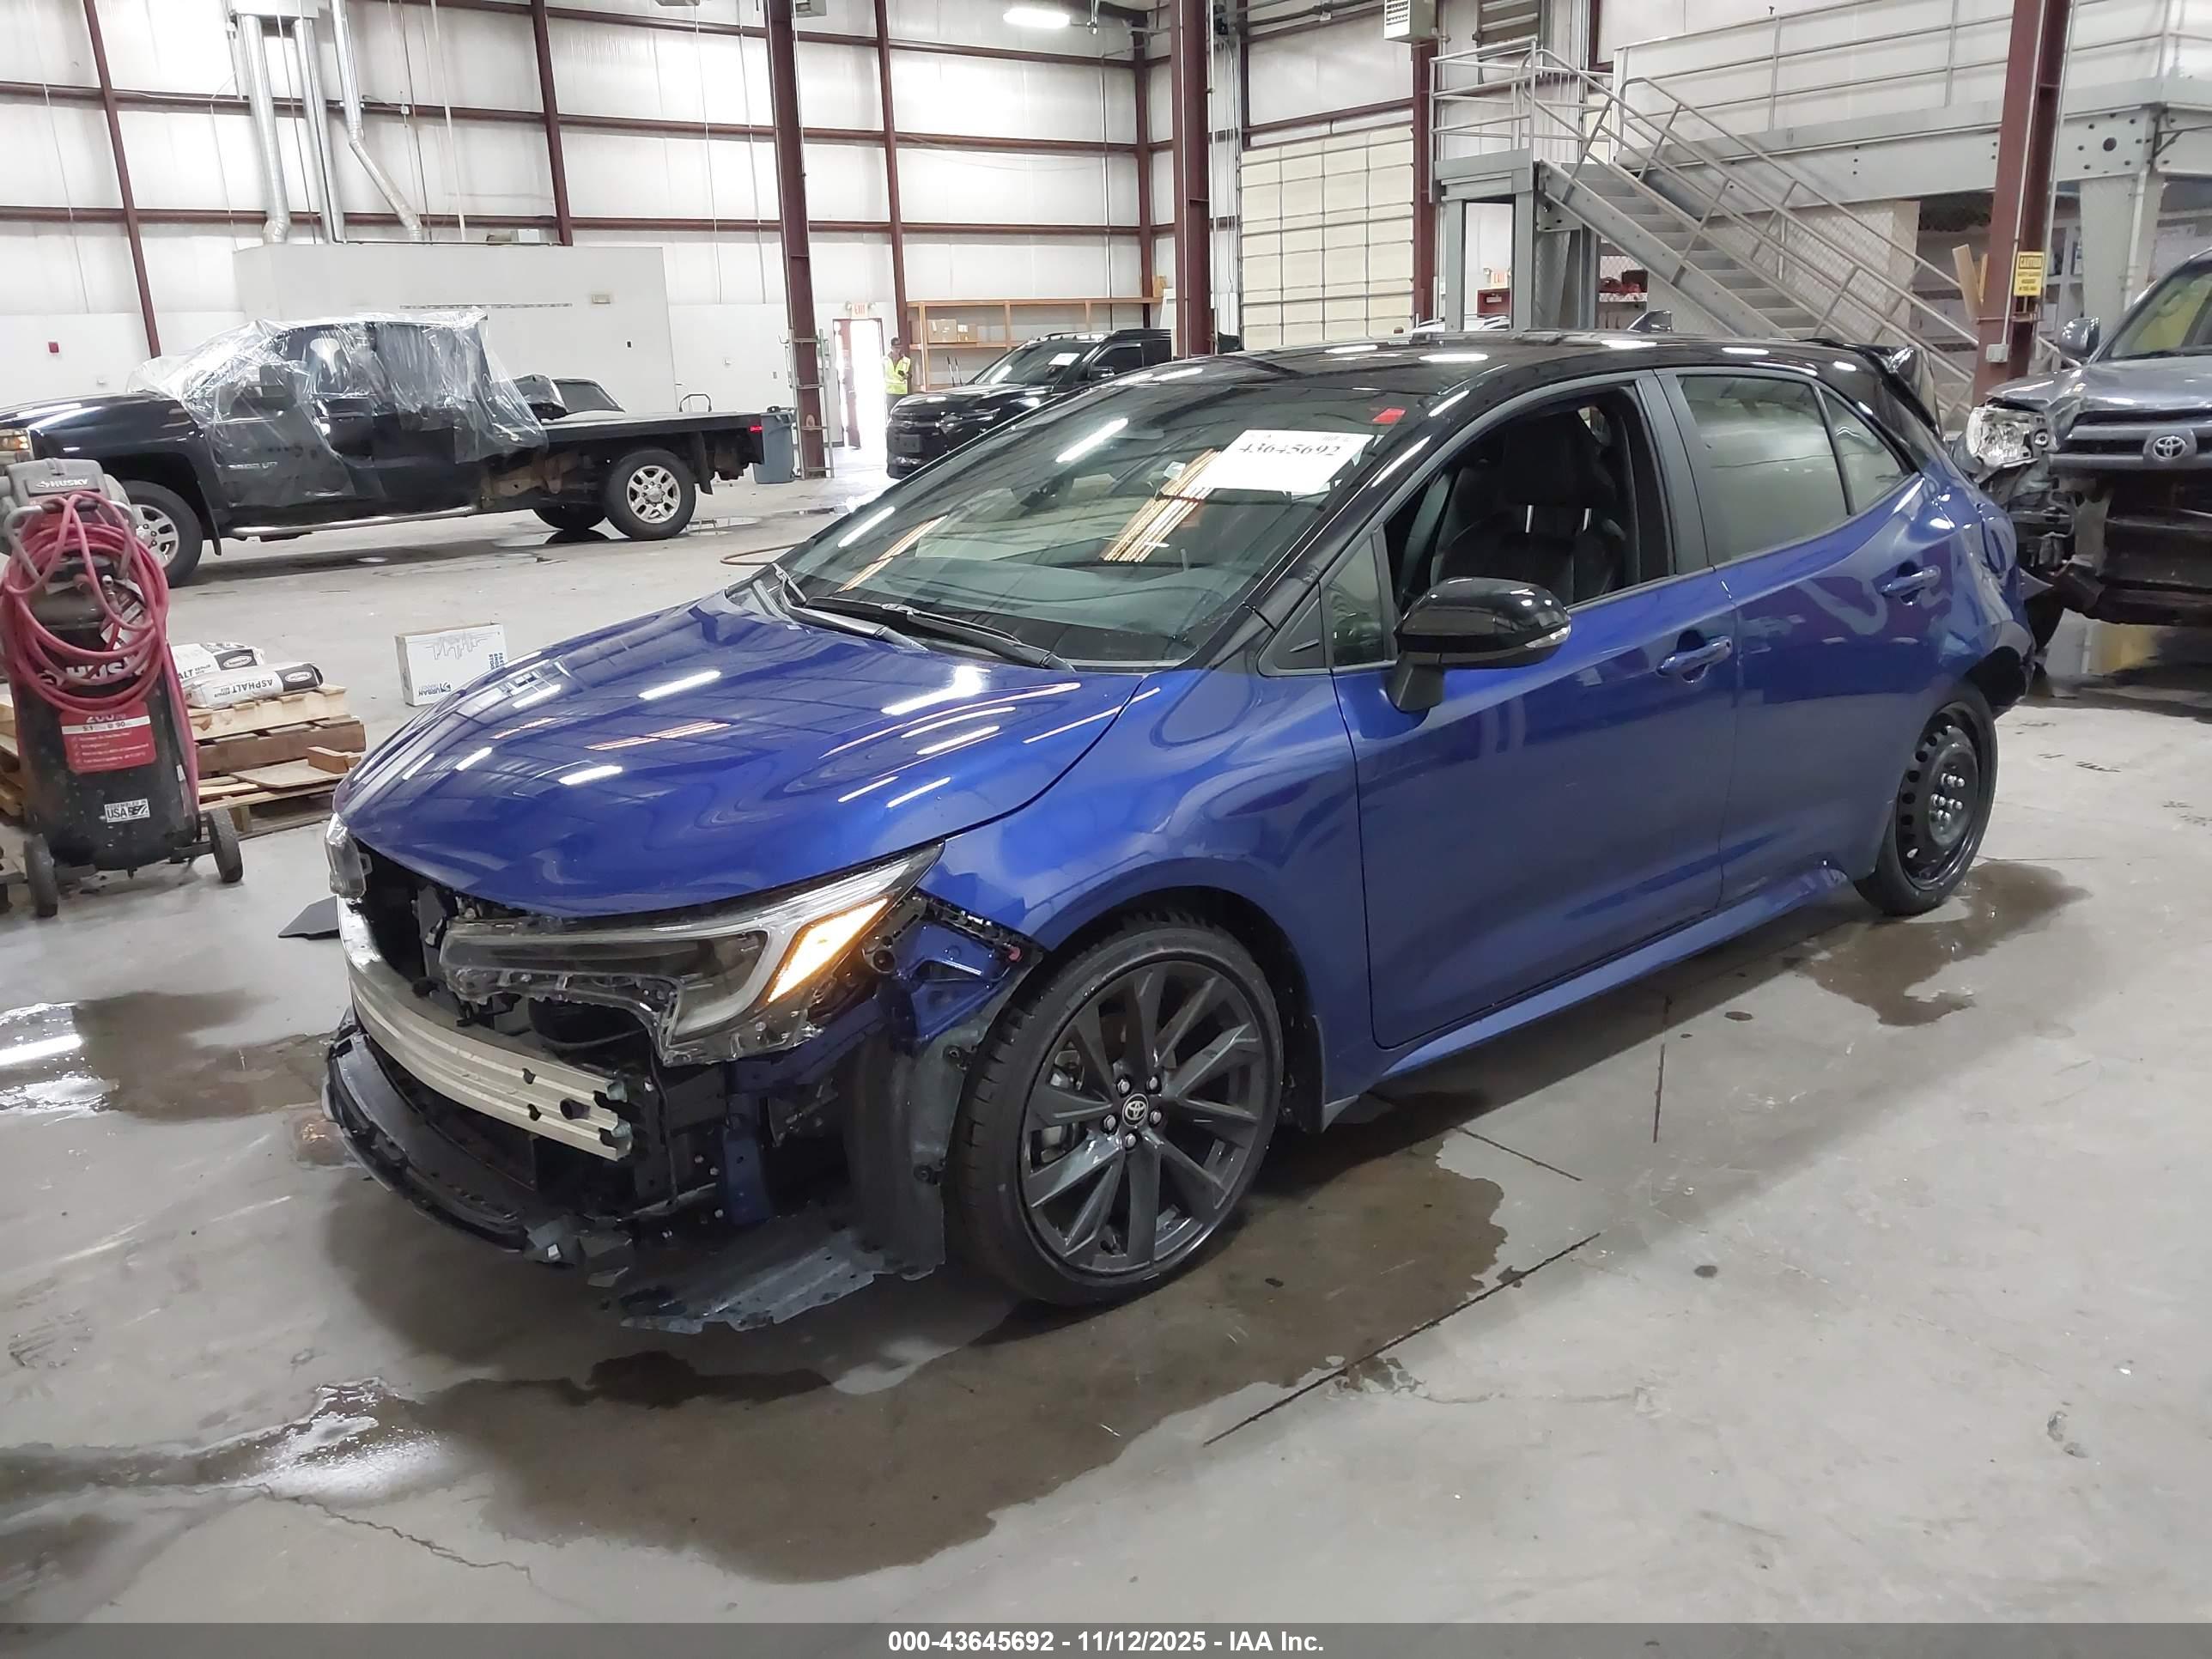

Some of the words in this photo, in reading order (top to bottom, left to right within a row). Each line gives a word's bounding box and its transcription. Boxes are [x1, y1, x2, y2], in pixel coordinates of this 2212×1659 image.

[1239, 443, 1341, 456] 43645692
[51, 479, 88, 488] HUSKY
[232, 679, 273, 693] ASPHALT
[106, 808, 127, 818] USA
